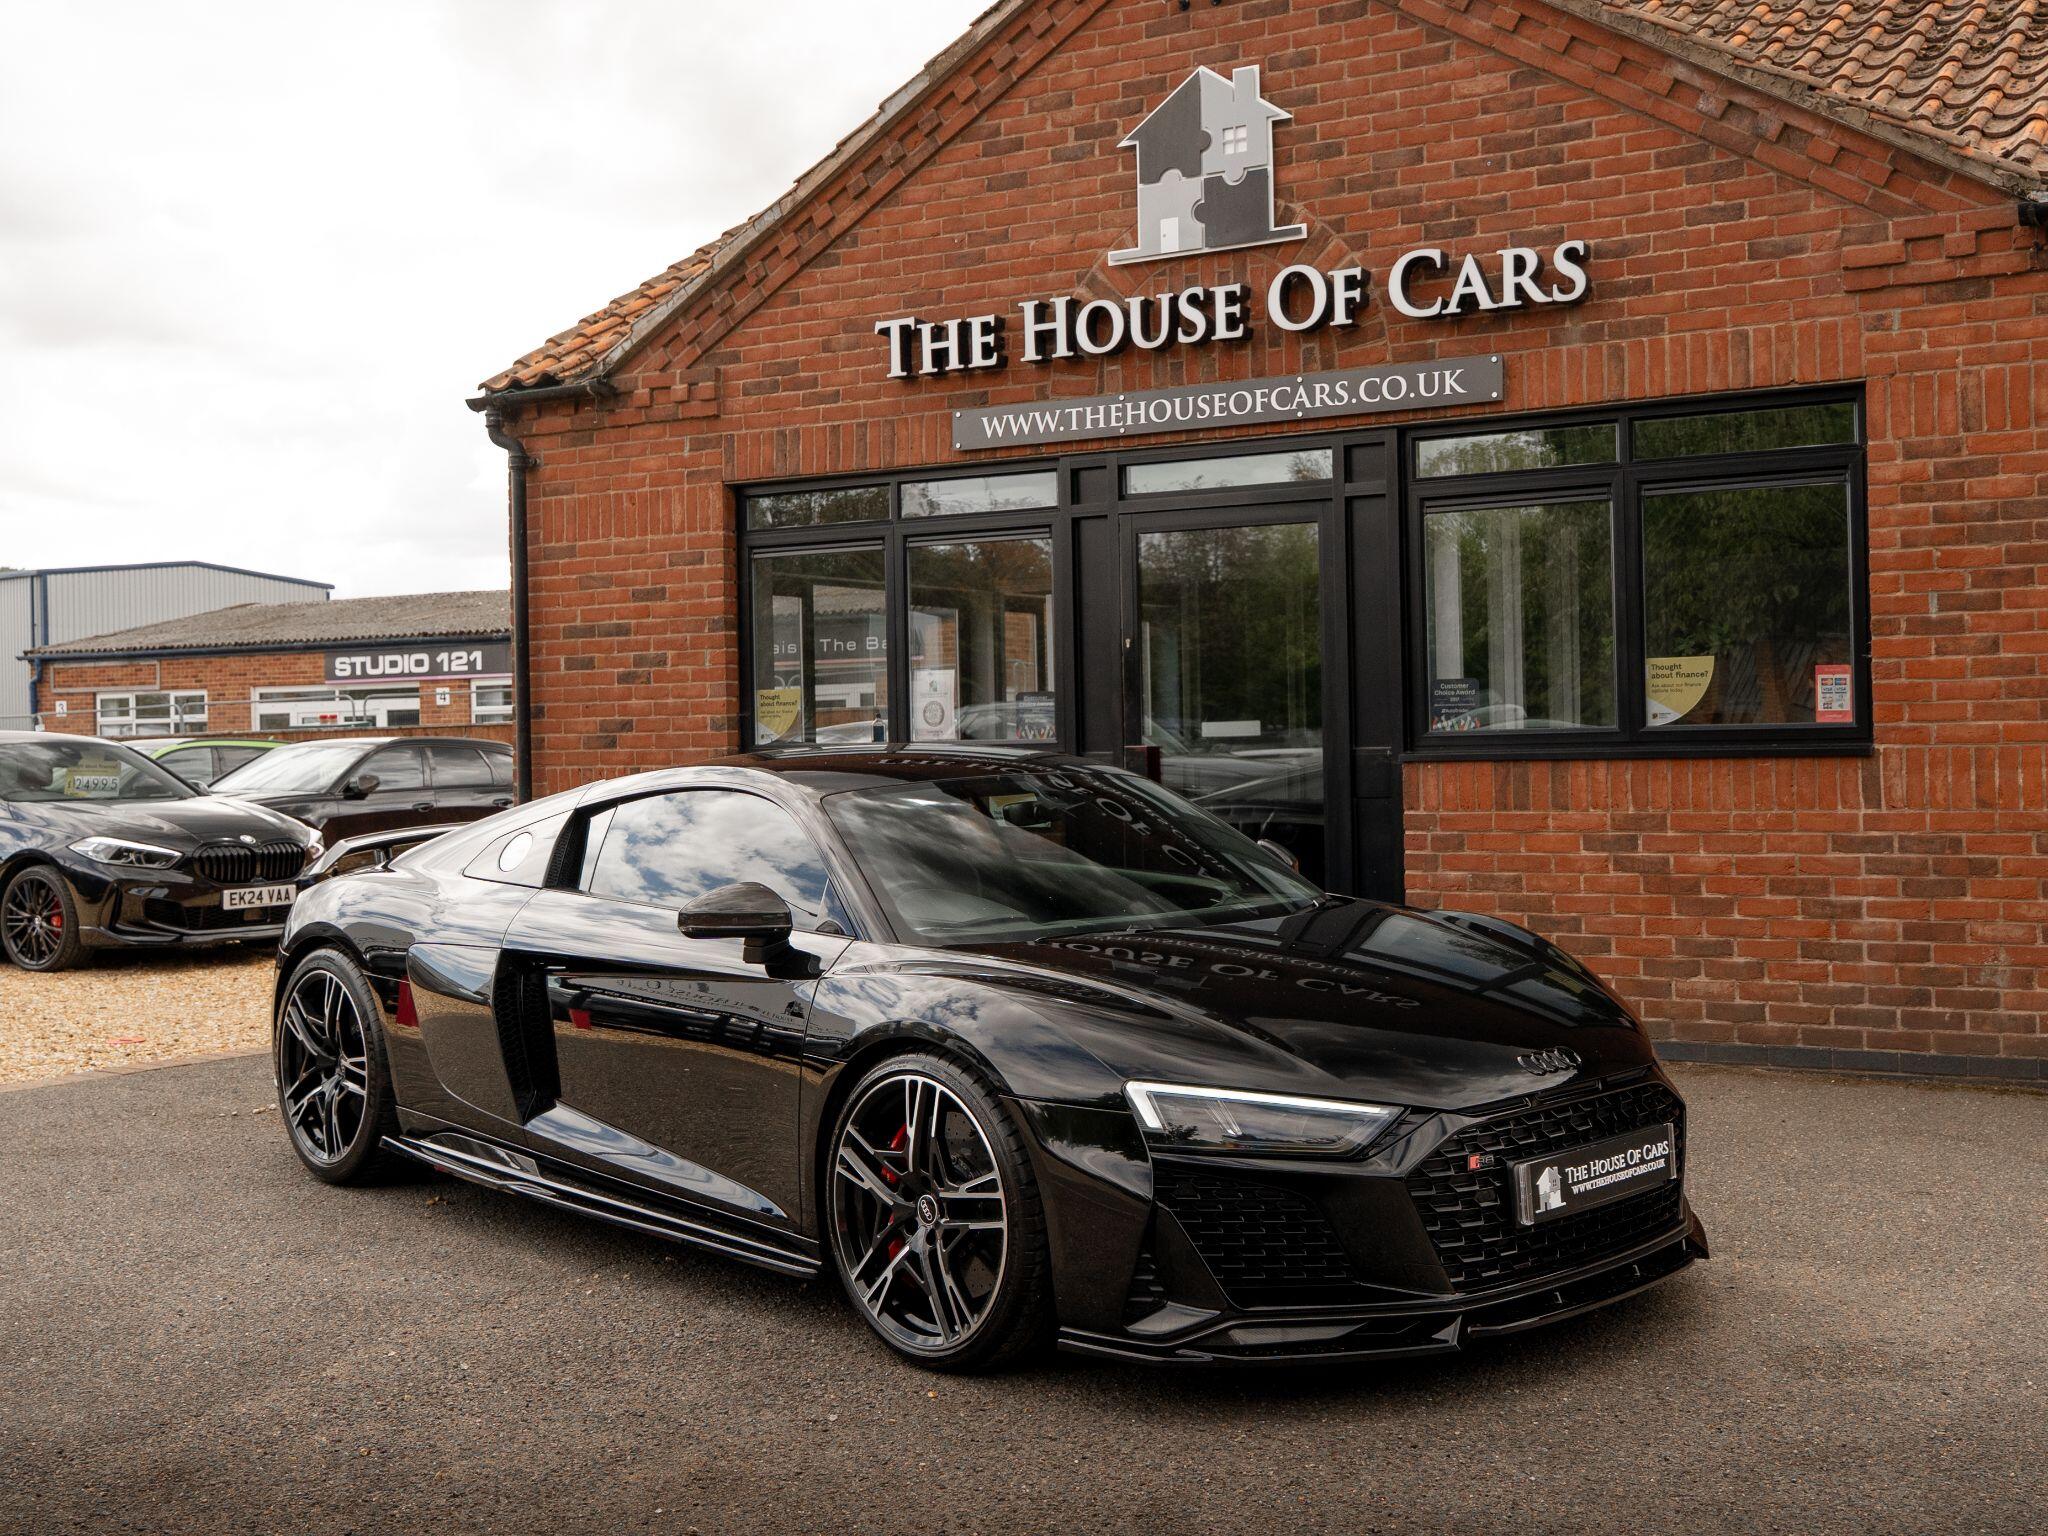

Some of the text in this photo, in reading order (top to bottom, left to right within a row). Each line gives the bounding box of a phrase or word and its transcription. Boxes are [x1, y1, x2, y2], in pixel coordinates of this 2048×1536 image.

[874, 239, 1589, 379] THE HOUSE OF CARS
[981, 368, 1468, 440] WWW.THEHOUSEOFCARS.CO.UK
[819, 638, 857, 653] The
[334, 650, 483, 677] STUDIO 121
[1651, 663, 1682, 671] Thought
[1676, 670, 1709, 678] finance?
[229, 887, 291, 906] EK24 VAA
[1565, 1140, 1669, 1184] THE HOUSE OF CARS
